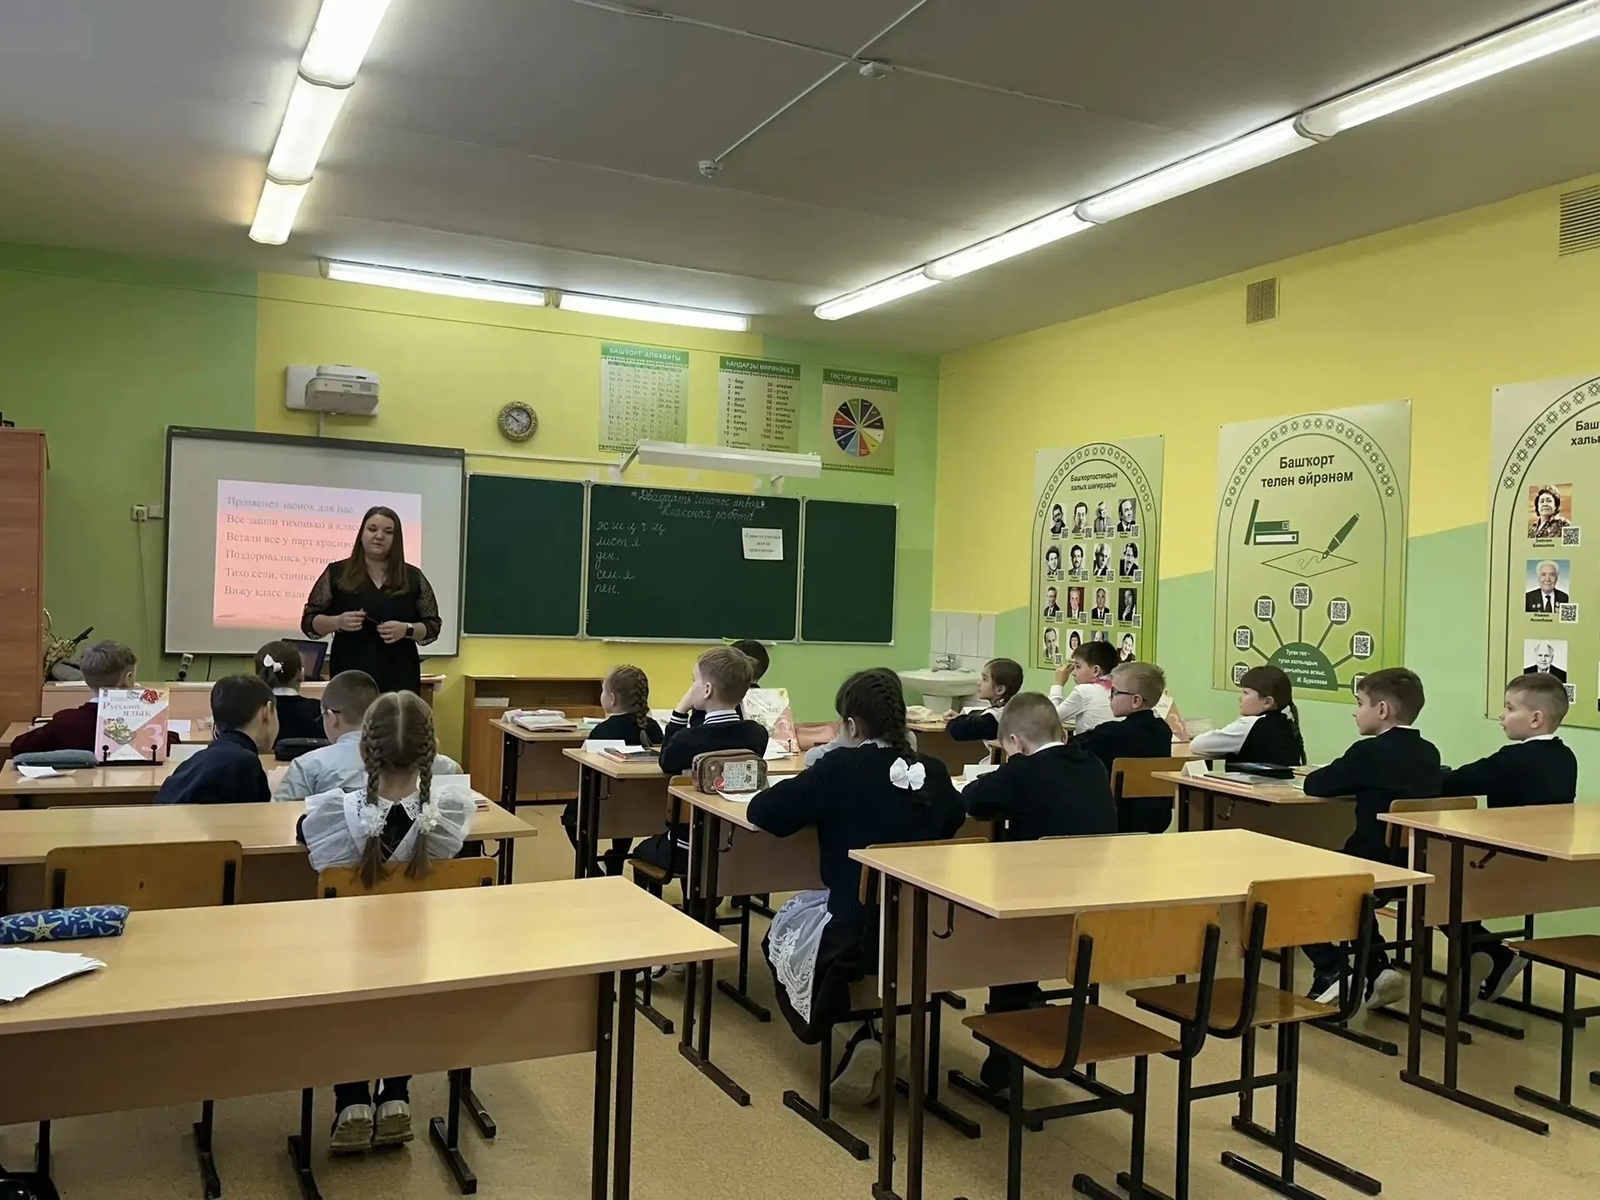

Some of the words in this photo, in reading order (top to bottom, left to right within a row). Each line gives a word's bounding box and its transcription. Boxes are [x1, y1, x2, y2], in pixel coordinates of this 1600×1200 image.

[1279, 454, 1335, 470] Башҡорт
[1261, 475, 1295, 488] телен
[1298, 471, 1353, 488] өйрәнәм
[227, 514, 245, 524] Все
[281, 519, 325, 529] тихонько
[226, 532, 261, 543] Встали
[264, 536, 279, 544] все
[281, 537, 289, 547] у
[291, 538, 314, 548] парт
[225, 550, 301, 564] Поздоровались
[224, 567, 250, 578] Тихо
[251, 570, 277, 580] сели,
[224, 585, 253, 598] Вижу
[254, 588, 282, 598] класс
[284, 590, 305, 600] наш
